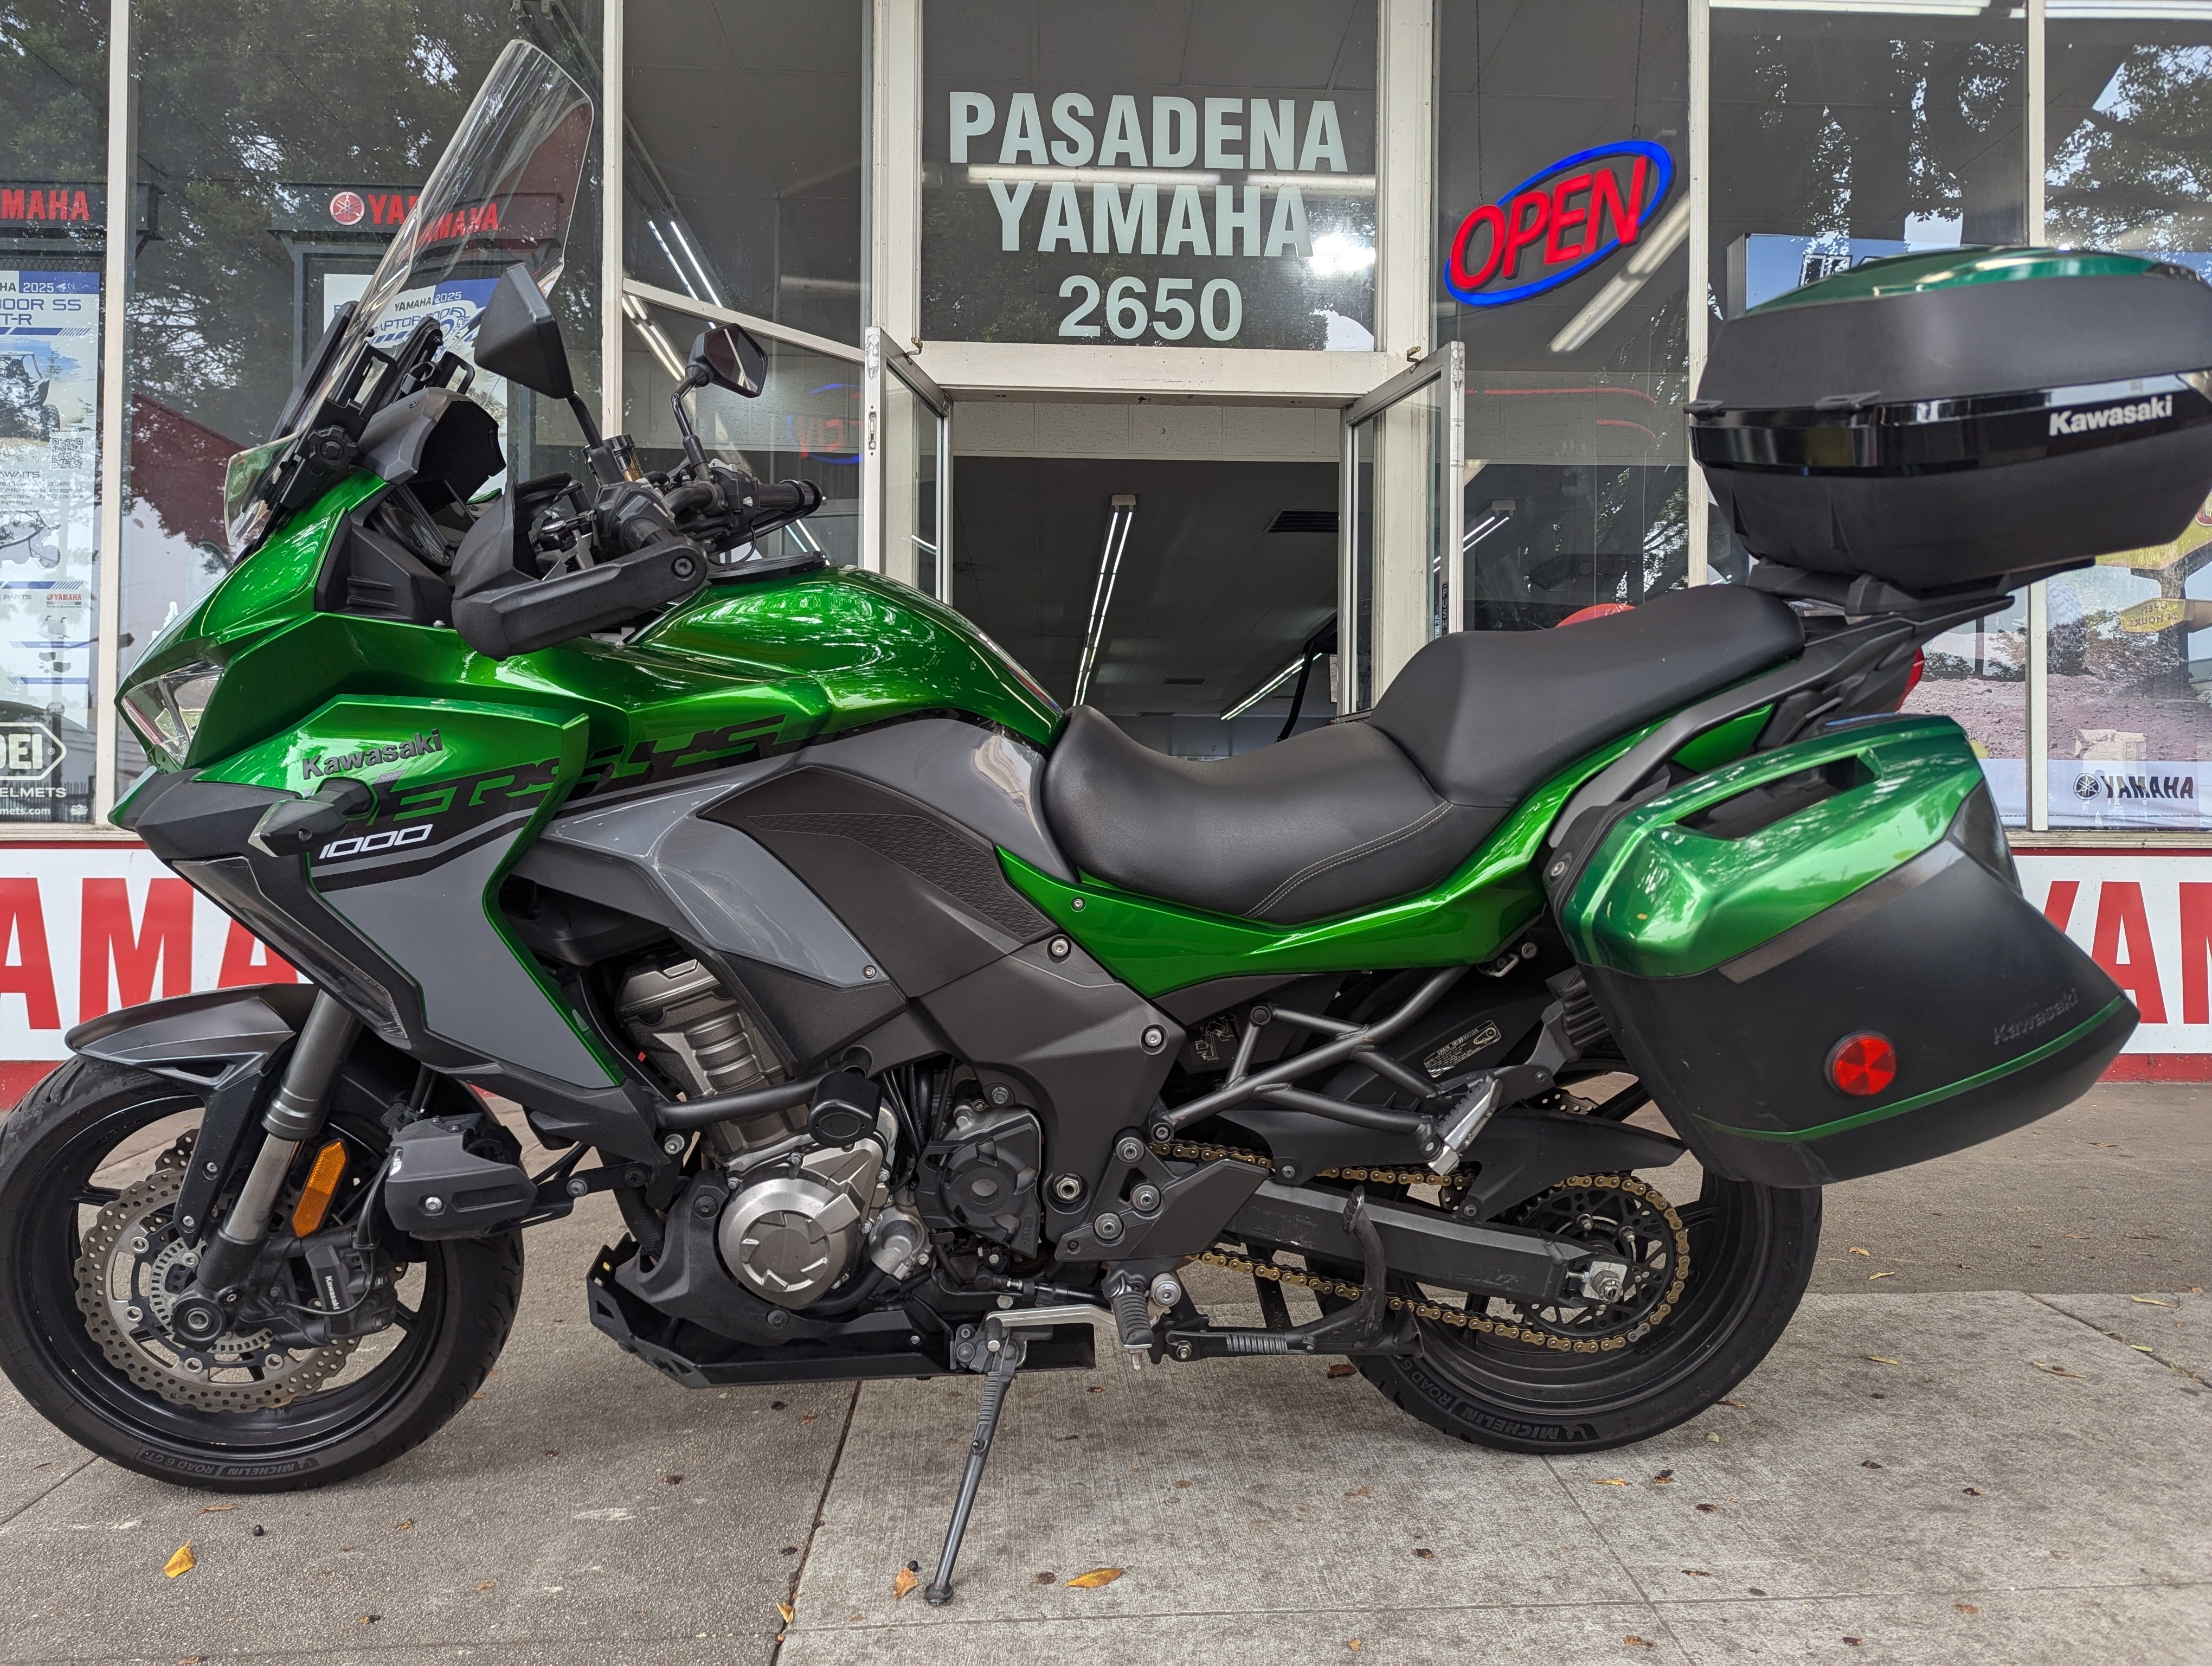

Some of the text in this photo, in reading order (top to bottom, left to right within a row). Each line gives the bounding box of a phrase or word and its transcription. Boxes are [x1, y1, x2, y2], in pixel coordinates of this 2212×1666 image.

[950, 91, 1348, 172] PASADENA
[0, 189, 91, 221] MAHA
[986, 180, 1314, 258] YAMAHA
[1450, 156, 1648, 289] OPEN
[23, 283, 54, 293] 2025
[53, 299, 81, 311] SS
[395, 291, 462, 312] YAMAHA 2025
[1058, 275, 1243, 341] 2650
[2049, 394, 2173, 437] Kawasaki
[0, 734, 43, 769] EI
[303, 728, 443, 780] Kawasaki
[2100, 776, 2194, 799] YAMAHA
[319, 824, 433, 859] 1000
[1994, 987, 2078, 1046] Kawasaki
[325, 1276, 340, 1310] Kawasaki
[1411, 1370, 1452, 1405] ROAD
[1462, 1406, 1560, 1440] MICHELIN
[145, 1453, 163, 1463] GT
[177, 1461, 215, 1474] ROAD
[227, 1463, 295, 1476] MICHELIN
